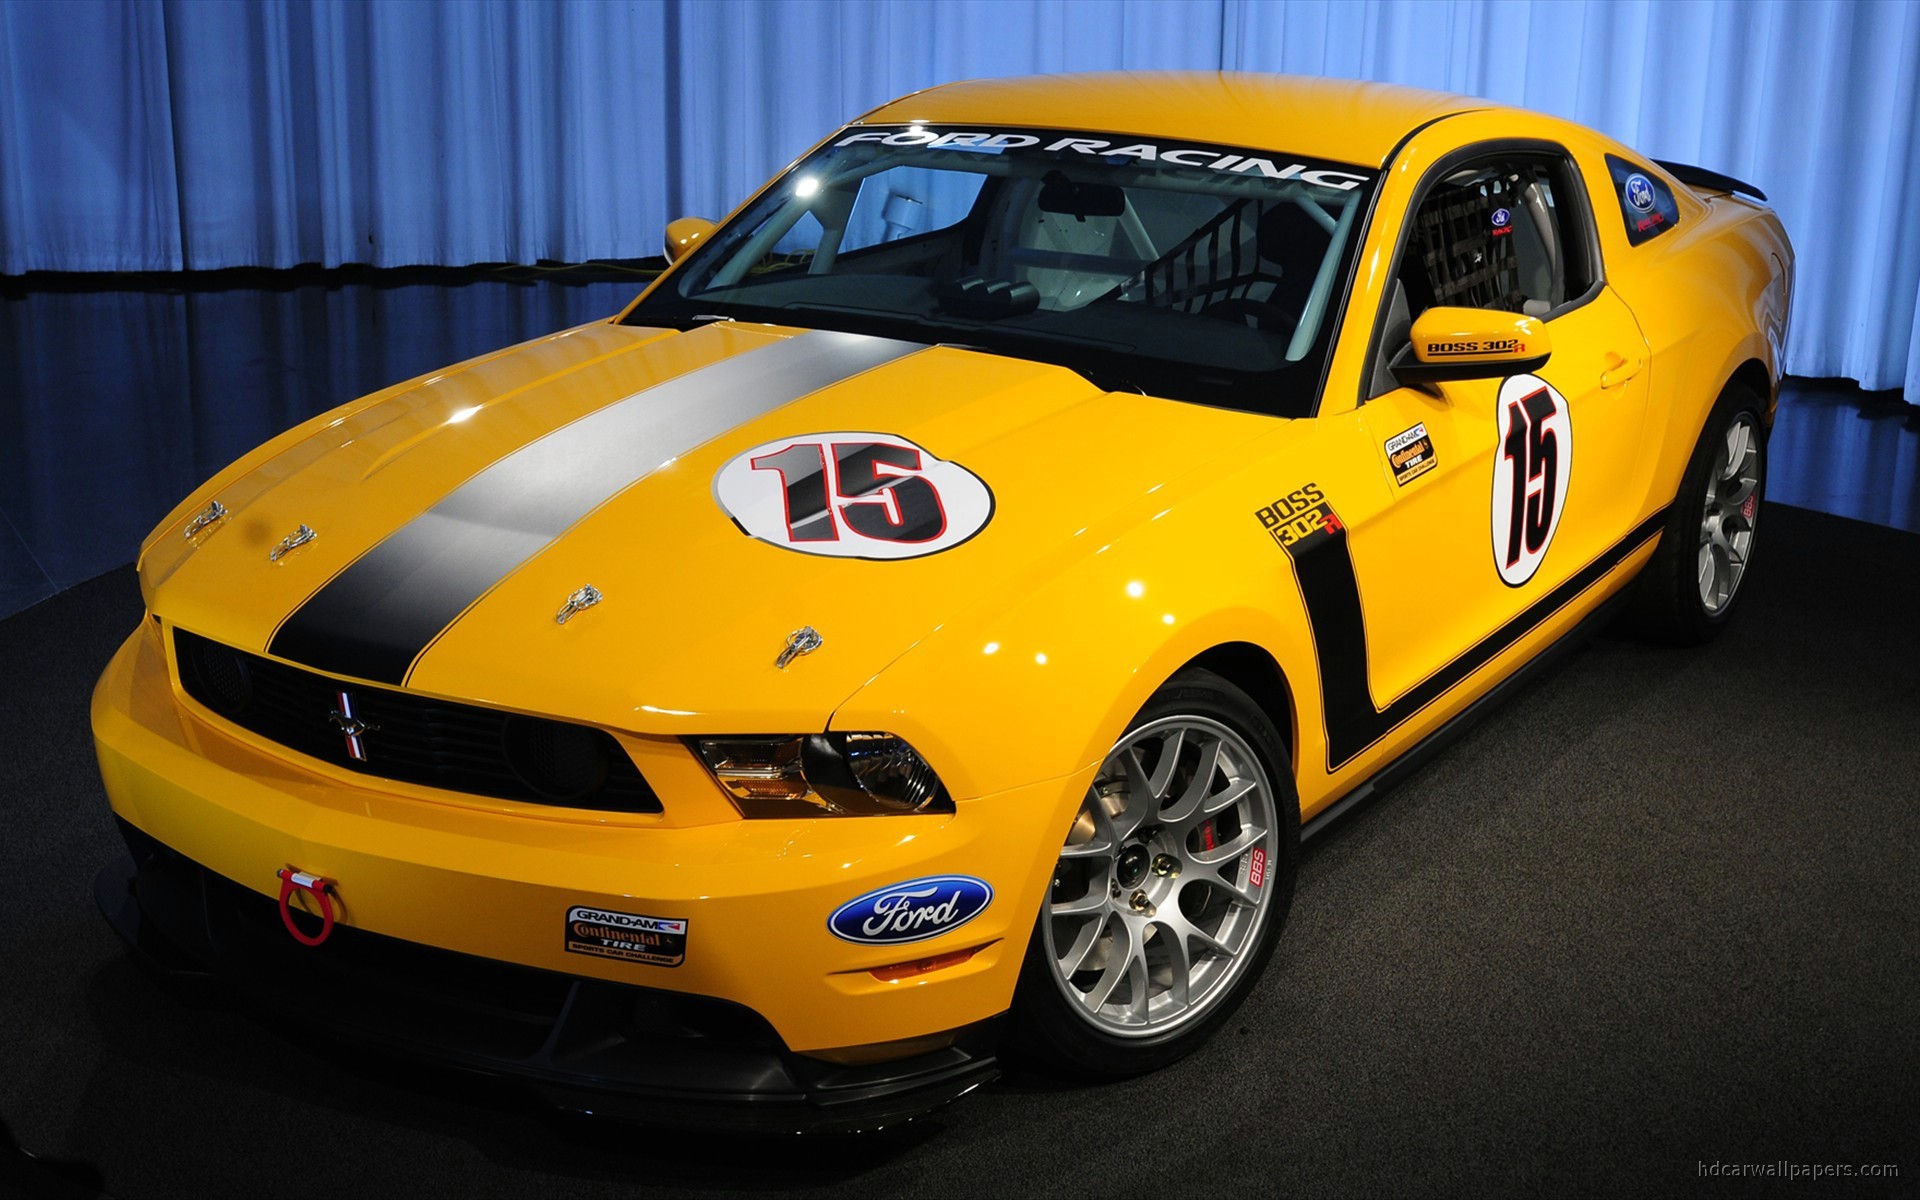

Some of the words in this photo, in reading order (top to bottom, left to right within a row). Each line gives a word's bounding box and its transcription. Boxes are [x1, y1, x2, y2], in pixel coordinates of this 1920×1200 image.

[833, 129, 1040, 149] FORD
[1046, 137, 1370, 190] RACING
[1427, 342, 1478, 352] BOSS
[1405, 454, 1423, 468] TIRE
[1504, 385, 1557, 570] 15
[750, 442, 947, 544] 15
[1254, 482, 1324, 529] BOSS
[1251, 849, 1264, 886] BBS
[576, 910, 658, 930] GRAND-AM
[862, 886, 962, 936] Ford
[573, 922, 661, 946] Continental
[601, 939, 647, 951] TIRE
[572, 943, 605, 953] SPORTS
[606, 948, 624, 956] CAR
[626, 952, 674, 963] CHALLENGE
